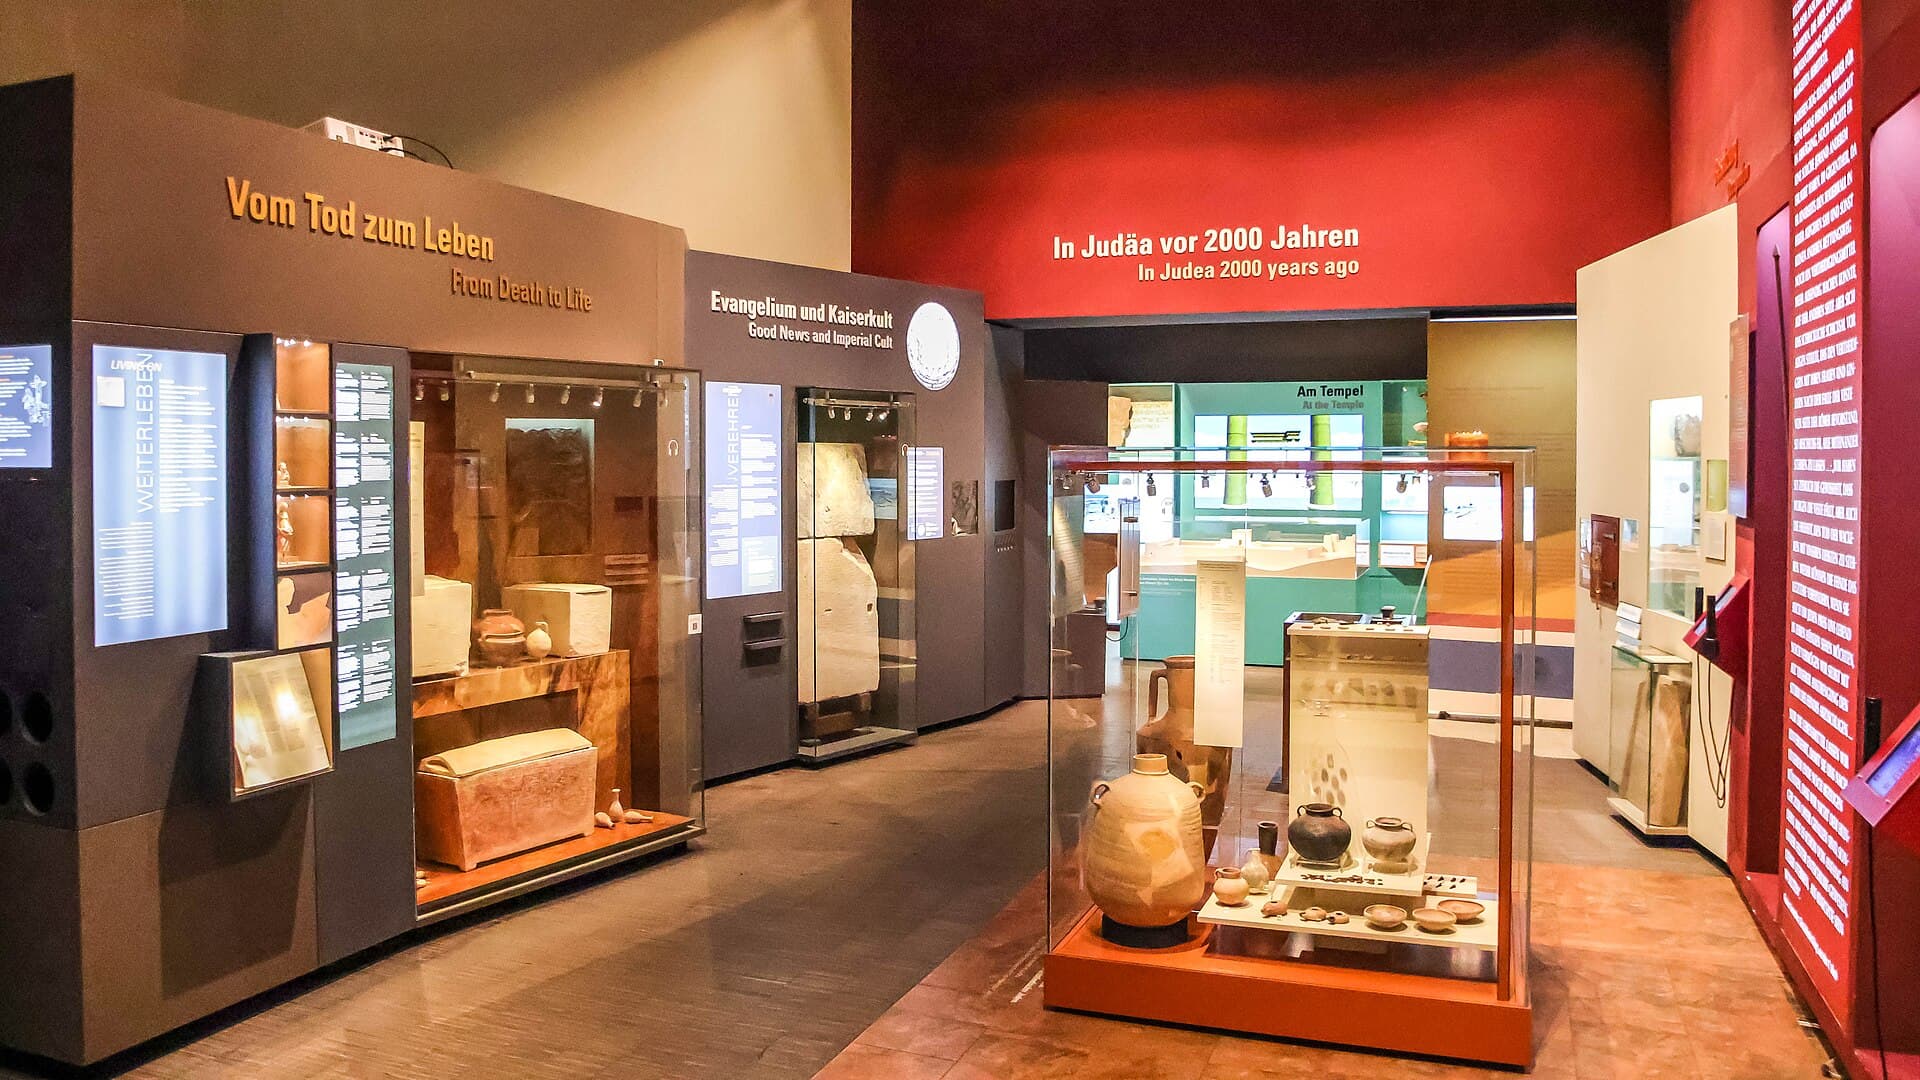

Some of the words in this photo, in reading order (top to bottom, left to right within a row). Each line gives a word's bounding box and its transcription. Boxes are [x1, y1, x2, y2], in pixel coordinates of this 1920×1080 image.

[227, 176, 296, 227] Vom
[305, 192, 356, 237] Tod
[363, 214, 416, 248] zum
[424, 216, 494, 261] Leben
[1053, 236, 1075, 259] In
[1081, 233, 1153, 258] Judäa
[1159, 235, 1198, 254] vor
[1204, 226, 1263, 252] 2000
[1270, 224, 1359, 250] Jahren
[1138, 263, 1155, 281] In
[1160, 260, 1215, 281] Judea
[1220, 259, 1263, 278] 2000
[1267, 261, 1319, 281] years
[1324, 260, 1360, 279] ago
[451, 267, 494, 298] From
[498, 274, 544, 306] Death
[548, 286, 562, 308] to
[566, 286, 593, 313] Life
[711, 290, 797, 321] Evangelium
[800, 304, 825, 323] und
[828, 304, 893, 330] Kaiserkult
[749, 322, 777, 341] Good
[779, 325, 810, 343] News
[812, 329, 831, 344] and
[833, 330, 873, 349] Imperial
[874, 334, 893, 350] Cult
[1297, 386, 1317, 397] Am
[1320, 384, 1364, 399] Tempel
[1303, 401, 1313, 409] At
[1315, 401, 1329, 410] the
[1331, 400, 1364, 411] Temple
[136, 353, 154, 513] WEITERLEBEN
